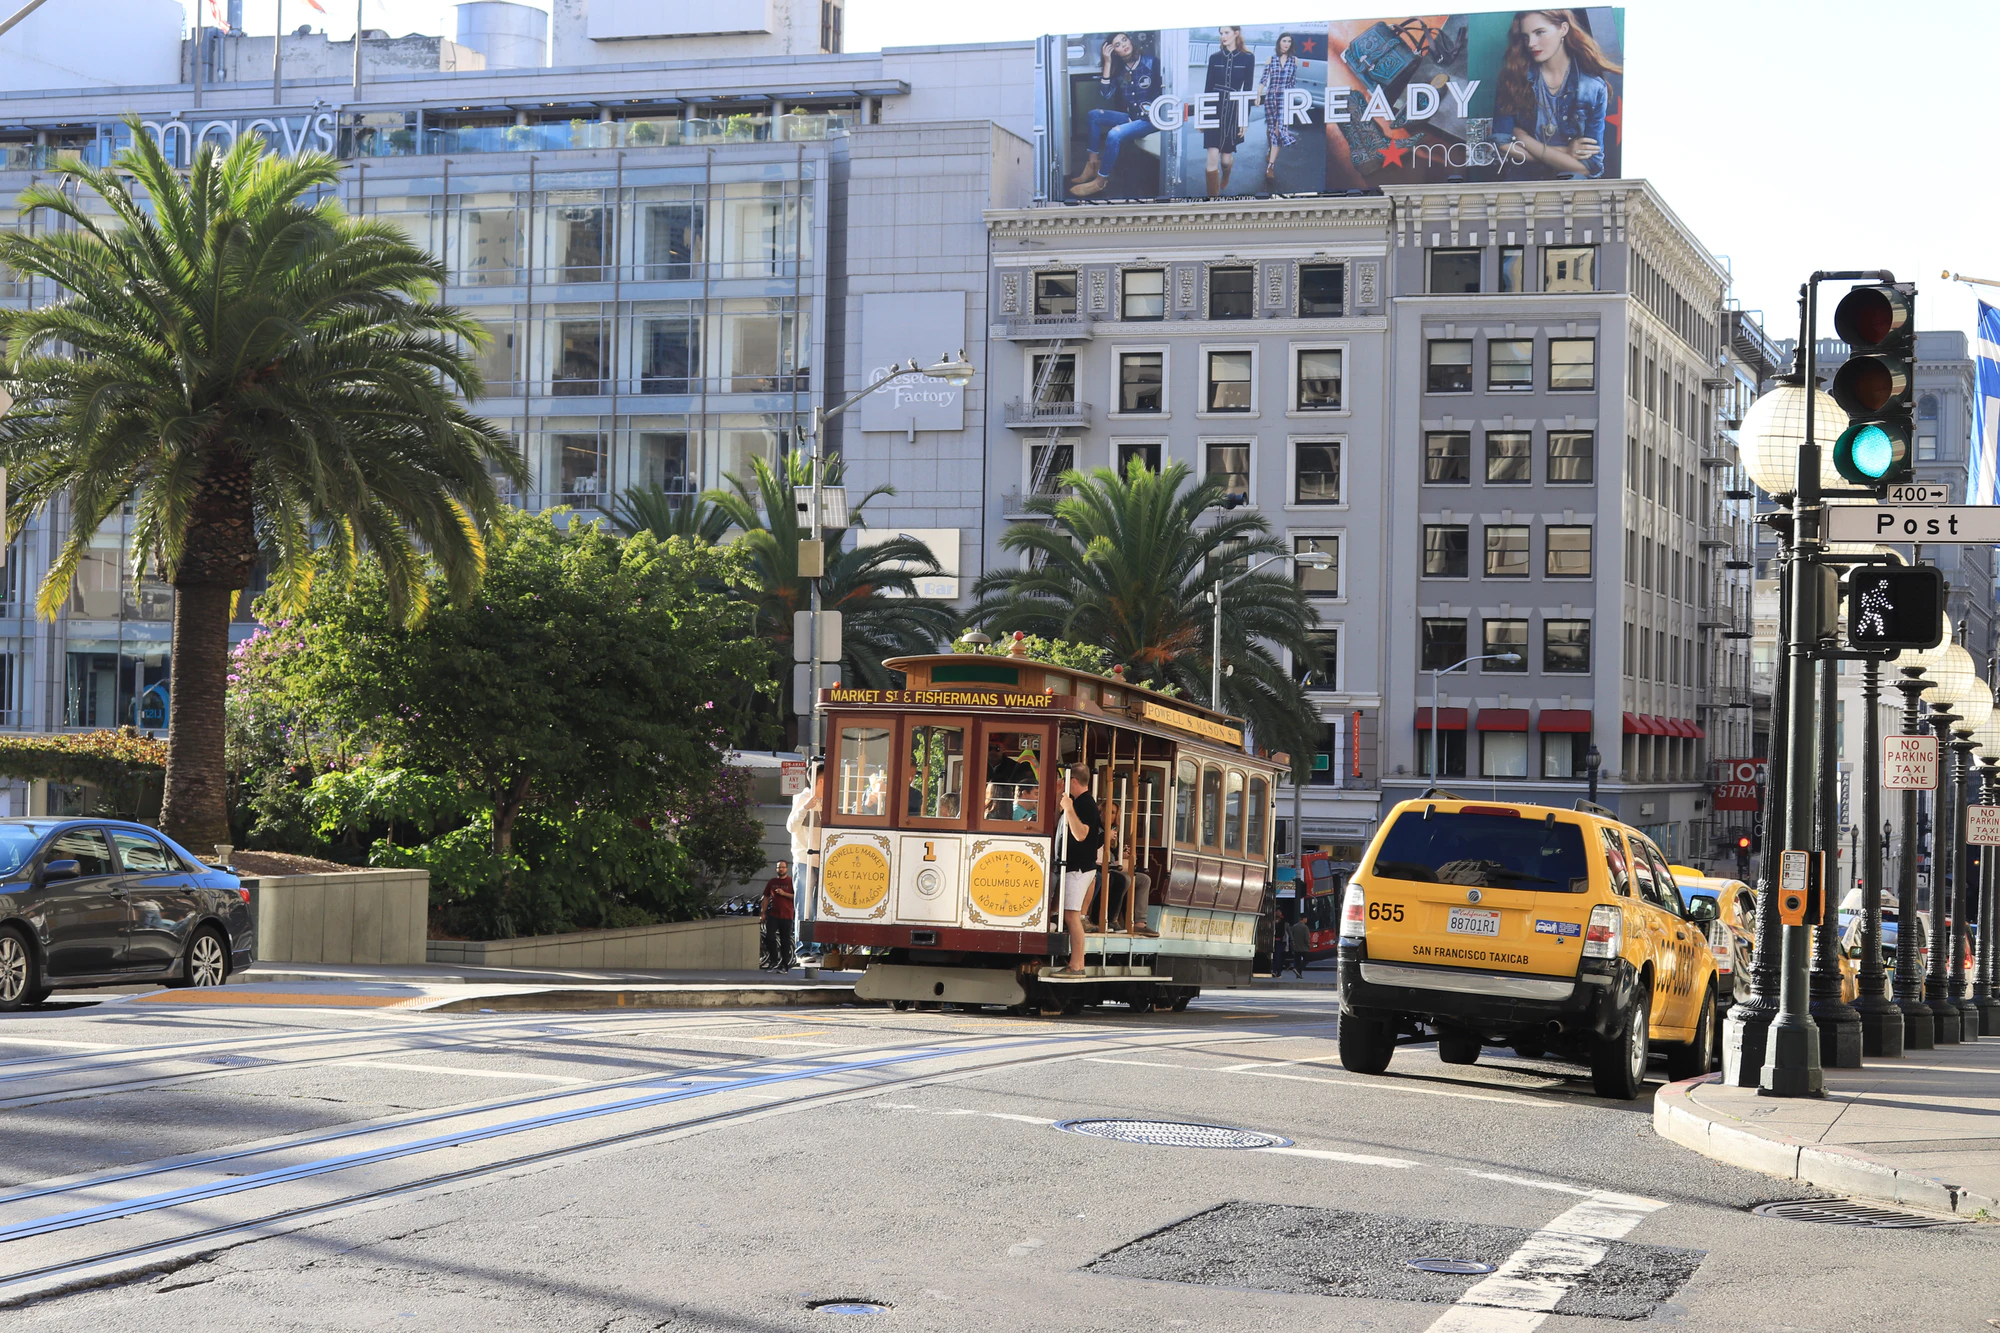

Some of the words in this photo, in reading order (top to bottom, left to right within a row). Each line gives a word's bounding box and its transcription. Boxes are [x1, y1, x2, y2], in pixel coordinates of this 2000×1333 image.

[1149, 90, 1257, 131] GET
[1283, 79, 1482, 126] READY
[887, 384, 957, 410] Factory
[1891, 486, 1927, 502] 400
[1876, 513, 1958, 535] Post
[924, 582, 955, 595] Bar
[830, 689, 880, 703] MARKET
[915, 691, 998, 706] FISHERMANS
[1003, 693, 1053, 707] WHARF
[1148, 704, 1184, 726] POWELL
[1196, 720, 1226, 737] MASON
[1021, 738, 1040, 750] 46
[1900, 740, 1920, 750] NO
[1887, 751, 1934, 762] PARKING
[1895, 765, 1927, 773] TAXI
[1892, 776, 1929, 784] ZONE
[1980, 809, 1995, 817] NO
[1973, 834, 2000, 842] ZONE
[1976, 826, 1999, 834] TAXI
[829, 847, 854, 867] POWELL
[861, 848, 885, 868] MARKET
[922, 841, 937, 861] 1
[979, 854, 1036, 872] CHINATOWN
[826, 869, 843, 879] BAY
[851, 871, 885, 882] TAYLOR
[973, 877, 1021, 888] COLUMBUS
[1022, 879, 1040, 888] AVE
[828, 881, 852, 905] POWELL
[859, 884, 883, 905] MASON
[978, 894, 1005, 912] NORTH
[1008, 896, 1034, 912] BEACH
[1369, 902, 1404, 922] 655
[1170, 917, 1197, 934] POWELL
[1450, 916, 1495, 933] 88701R1
[1412, 945, 1432, 956] SAN
[1434, 947, 1487, 961] FRANCISCO
[1489, 952, 1529, 965] TAXICAB
